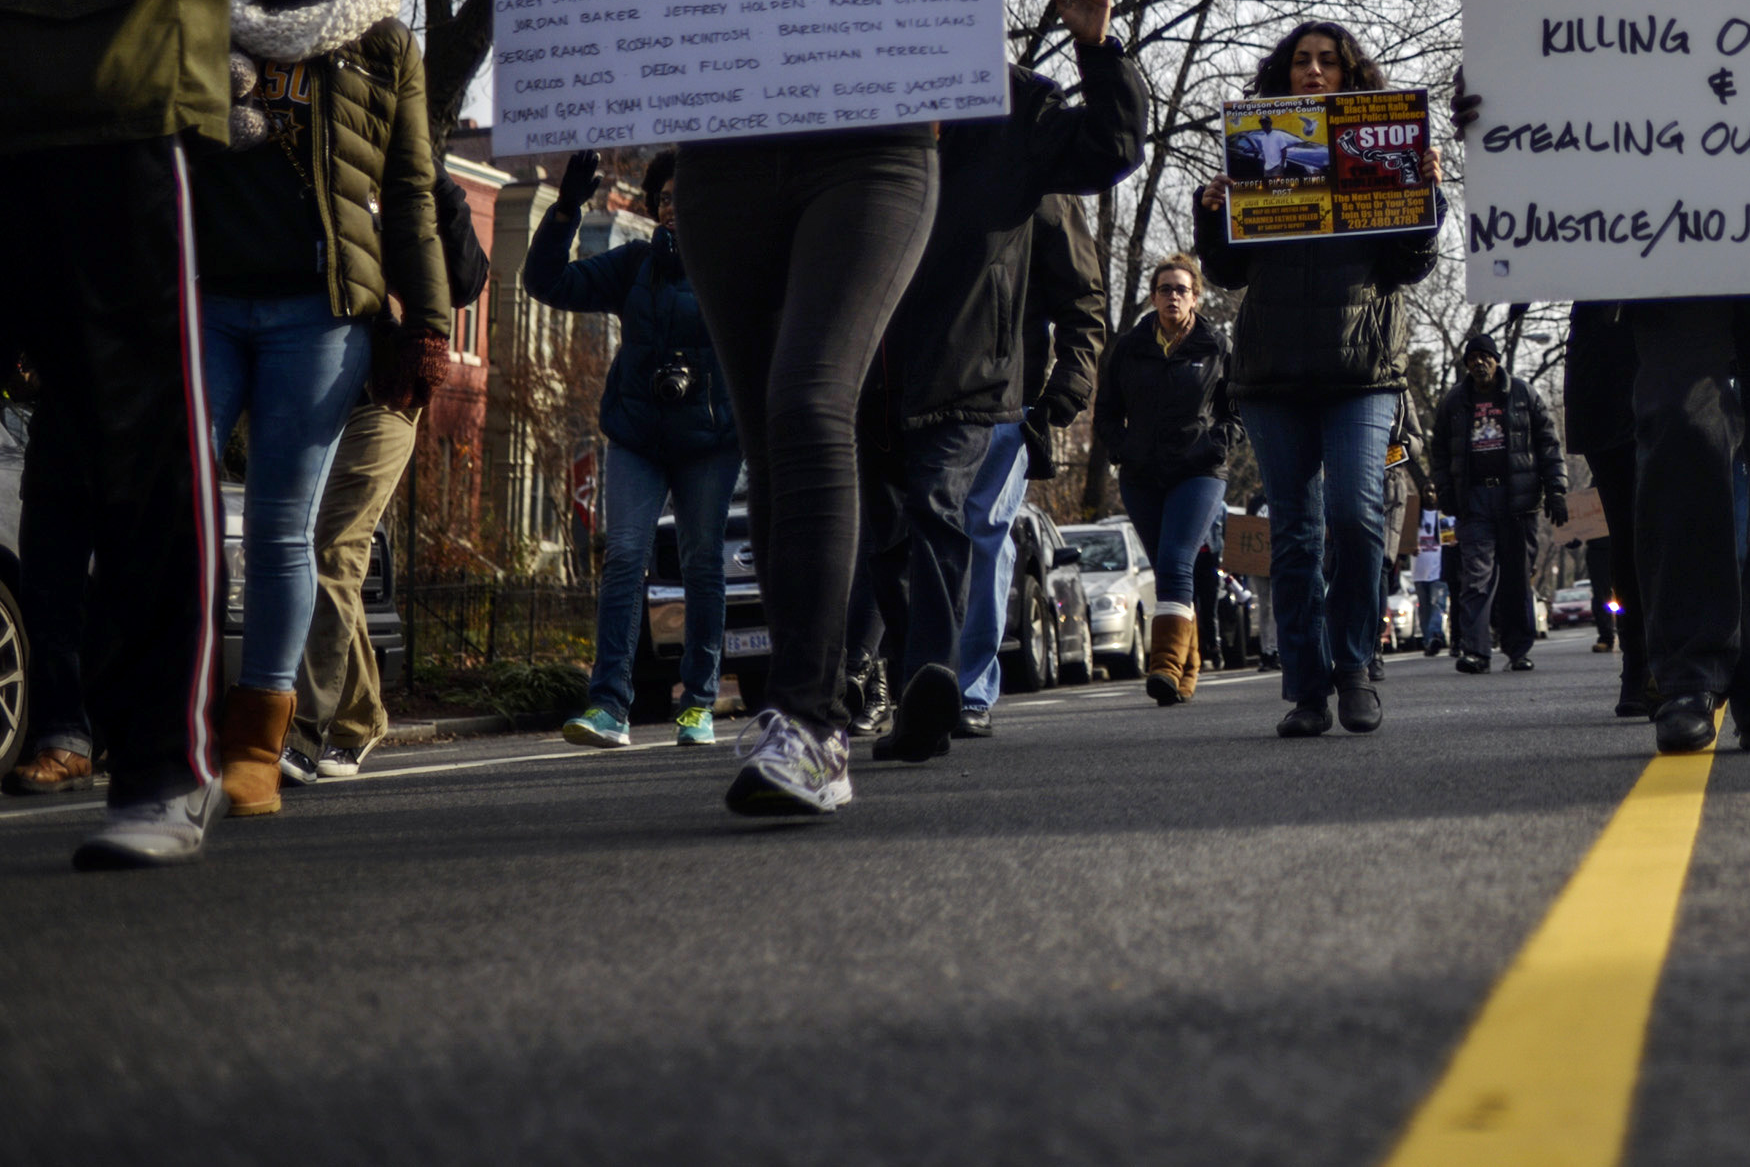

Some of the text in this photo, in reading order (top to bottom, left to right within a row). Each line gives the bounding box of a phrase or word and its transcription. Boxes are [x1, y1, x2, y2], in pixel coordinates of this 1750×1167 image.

[512, 16, 569, 34] JORDAN
[580, 8, 640, 24] BAKER
[664, 3, 728, 18] JEFFREY
[498, 48, 545, 66] SERGIO
[550, 43, 600, 58] RAMOS
[616, 36, 674, 52] ROSHAD
[778, 21, 883, 36] BARRINGTON
[896, 14, 976, 28] WILLIAMS
[1540, 15, 1691, 56] KILLING
[514, 78, 564, 94] CARLOS
[641, 64, 686, 78] DEION
[700, 58, 760, 72] FLUDD
[782, 48, 861, 66] JONATHAN
[876, 44, 950, 56] FERRELL
[502, 105, 548, 123] KIMANI
[555, 100, 596, 120] GRAY
[648, 88, 744, 110] LIVINGSTONE
[763, 85, 821, 98] LARRY
[833, 82, 896, 96] EUGENE
[906, 73, 964, 94] JACKSON
[970, 70, 991, 85] JR
[1232, 102, 1272, 110] Ferguson
[1274, 100, 1302, 108] Comes
[1336, 96, 1354, 106] Stop
[1356, 96, 1370, 104] The
[1372, 94, 1403, 103] Assault
[1256, 107, 1293, 115] George's
[1296, 105, 1326, 114] County
[1330, 111, 1426, 124] Against Police Violence
[1344, 103, 1408, 114] Black Men Rally
[526, 94, 1004, 150] MIRIAM CAREY CARTER DANTE PRICE BROWN
[1359, 124, 1419, 147] STOP
[1482, 118, 1685, 156] STEALING
[1334, 188, 1429, 202] The Next Victim Could
[1342, 212, 1359, 220] Join
[1384, 208, 1401, 216] Our
[1402, 206, 1424, 215] Fight
[1355, 202, 1372, 210] You
[1385, 200, 1405, 208] Your
